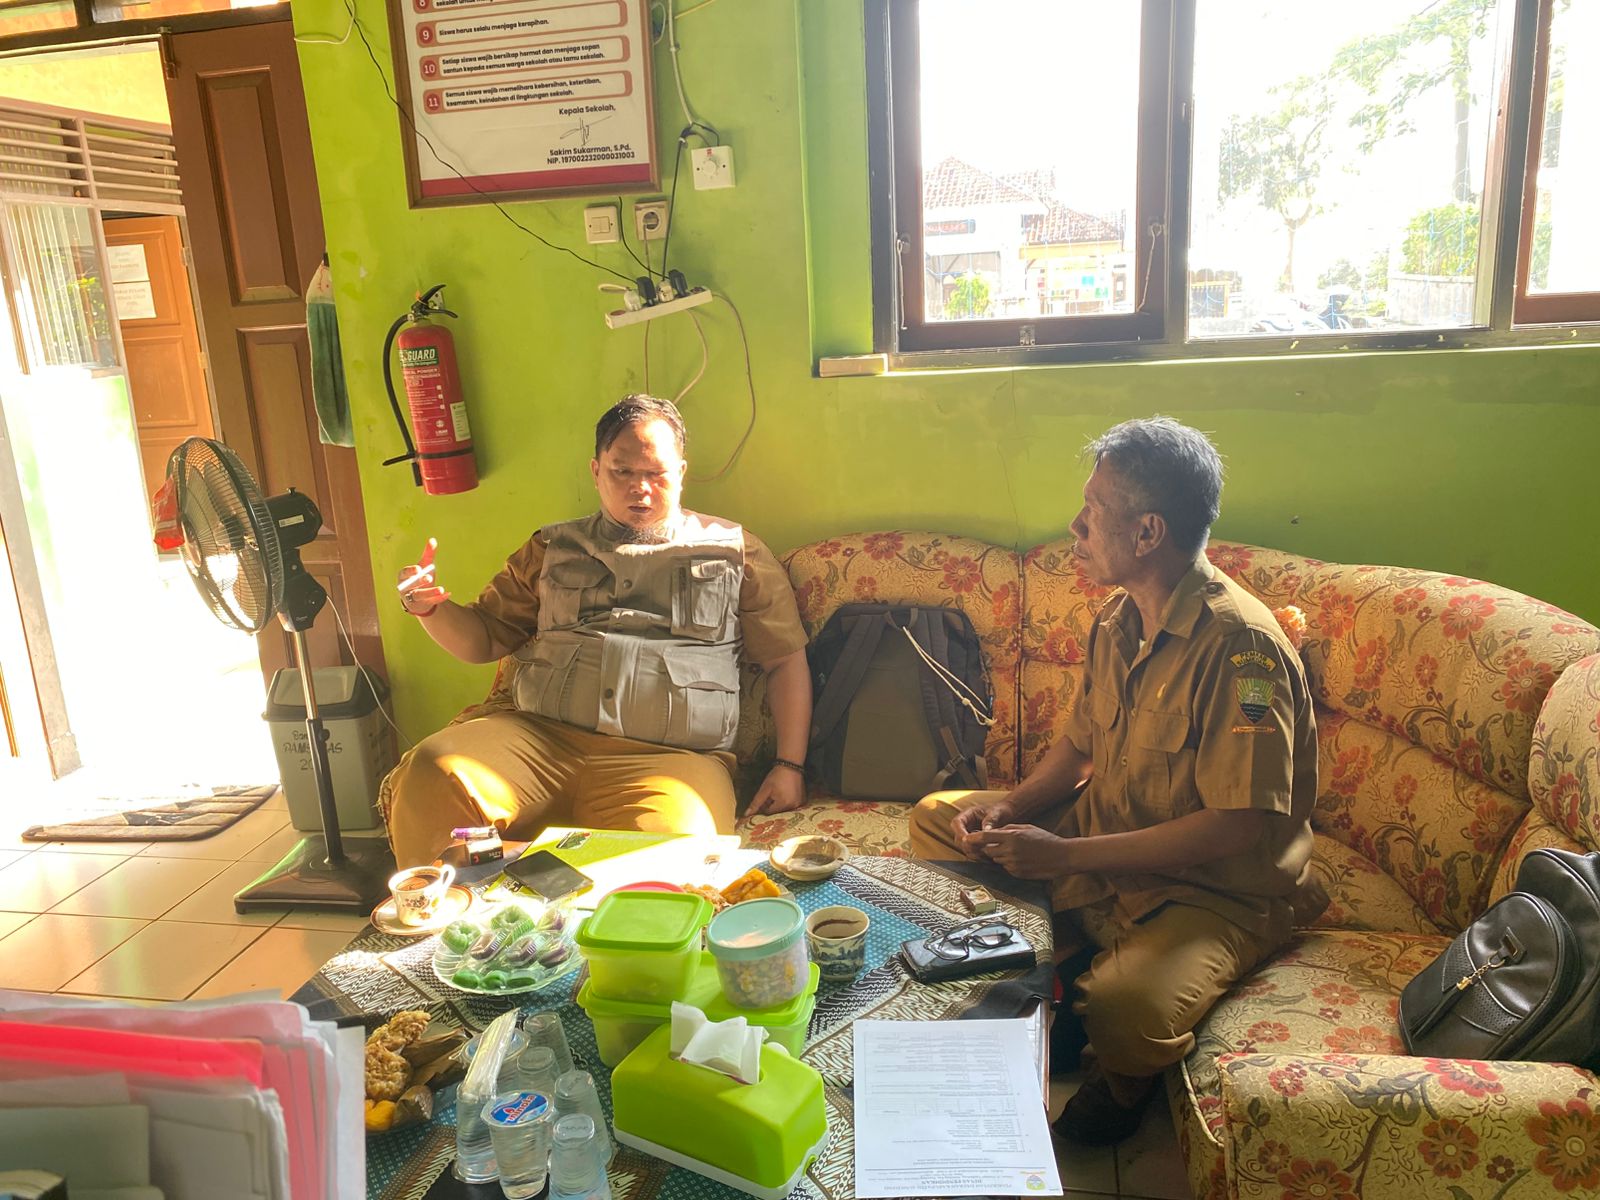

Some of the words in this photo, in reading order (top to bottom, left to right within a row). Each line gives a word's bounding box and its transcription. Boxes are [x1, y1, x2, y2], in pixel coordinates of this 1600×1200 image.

[473, 25, 490, 33] selalu
[491, 22, 517, 31] menjaga
[517, 19, 549, 28] kerapihan.
[422, 30, 430, 40] 9
[442, 57, 460, 65] Setiap
[477, 54, 493, 62] wajib
[493, 51, 519, 60] bersikap
[519, 49, 541, 57] hormat
[554, 45, 580, 54] menjaga
[424, 63, 436, 74] 10
[463, 64, 485, 72] kepada
[505, 60, 525, 68] warga
[525, 58, 548, 66] sekolah
[580, 52, 605, 60] sekolah.
[482, 87, 498, 95] wajib
[499, 84, 533, 92] memelihara
[534, 81, 568, 90] kebersihan,
[569, 78, 601, 87] ketertiban,
[428, 97, 440, 107] 11
[478, 95, 509, 105] keindahan
[516, 92, 549, 102] lingkungan
[549, 89, 574, 97] sekolah.
[558, 106, 584, 116] Kepala
[585, 103, 616, 113] Sekolah,
[549, 148, 572, 156] Sakim
[573, 145, 612, 154] Sukarman,
[613, 143, 632, 152] S.Pd.
[547, 157, 561, 165] NIP.
